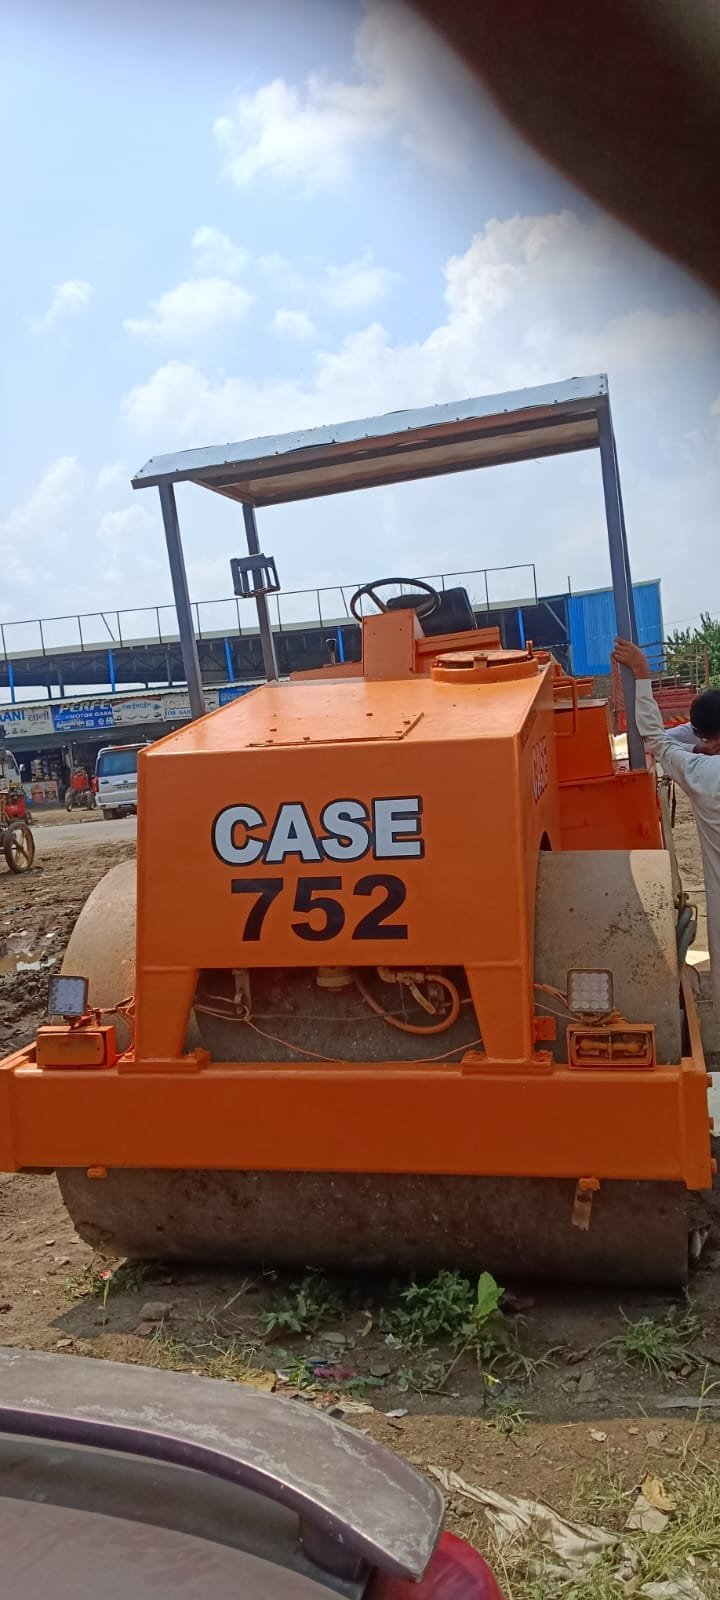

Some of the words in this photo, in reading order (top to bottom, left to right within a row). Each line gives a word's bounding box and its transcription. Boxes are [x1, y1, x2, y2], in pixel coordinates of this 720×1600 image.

[59, 700, 112, 714] PERFE
[211, 795, 425, 866] CASE
[231, 874, 408, 941] 752
